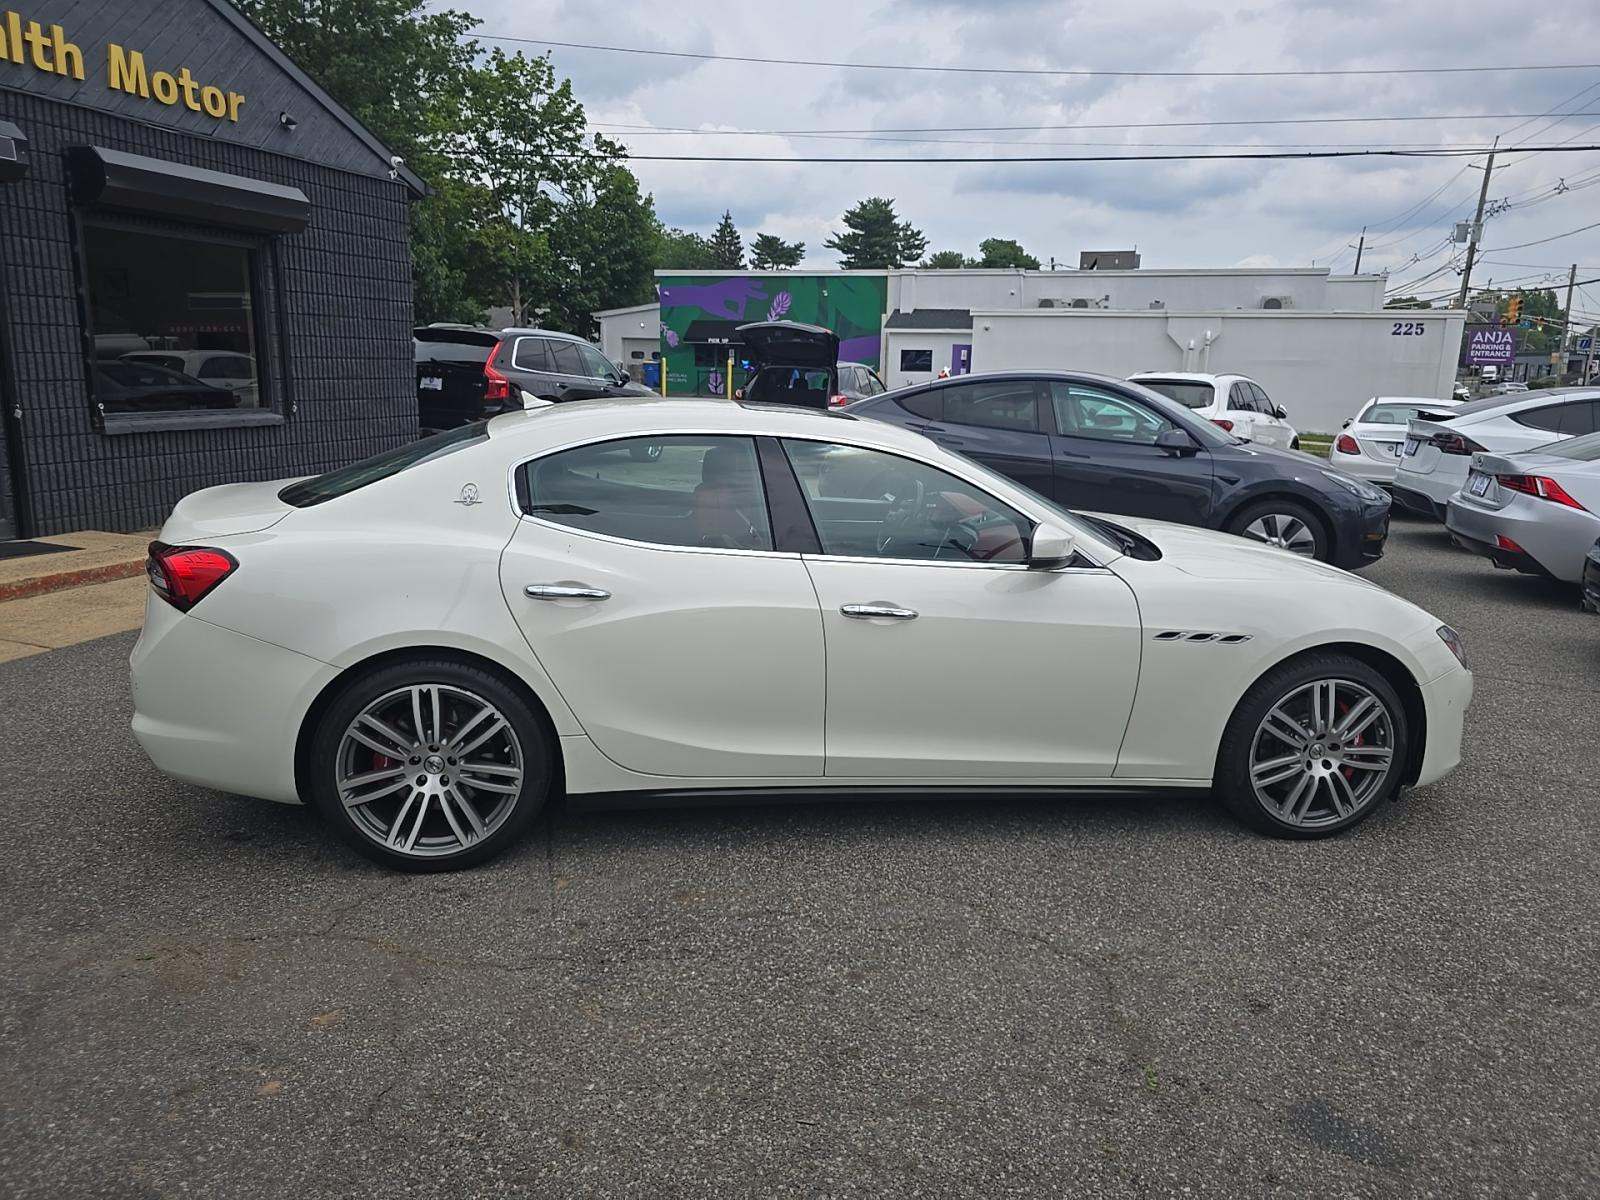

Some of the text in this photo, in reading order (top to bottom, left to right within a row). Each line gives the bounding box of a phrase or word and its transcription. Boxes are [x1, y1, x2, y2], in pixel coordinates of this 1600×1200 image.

[107, 43, 246, 122] Motor
[1391, 322, 1425, 336] 225
[1473, 331, 1512, 343] ANJA
